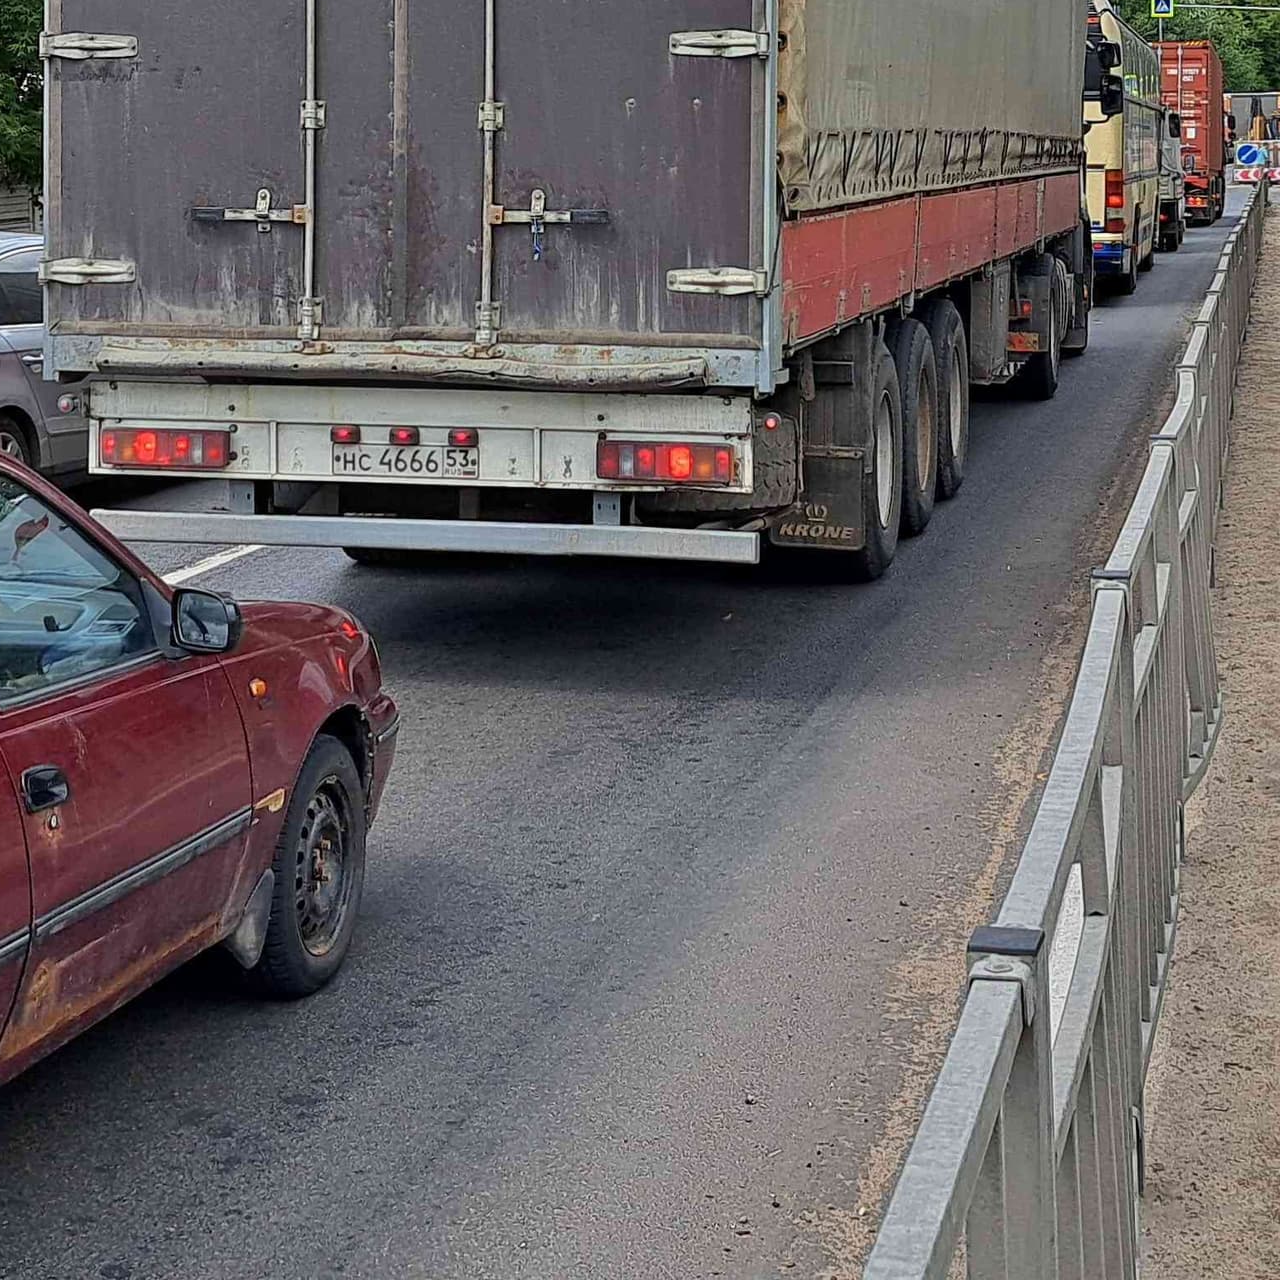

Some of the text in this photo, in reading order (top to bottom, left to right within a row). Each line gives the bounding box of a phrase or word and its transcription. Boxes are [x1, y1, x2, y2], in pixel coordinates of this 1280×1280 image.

[379, 448, 439, 473] 4666
[446, 450, 470, 468] 53
[780, 523, 854, 540] KRONE
